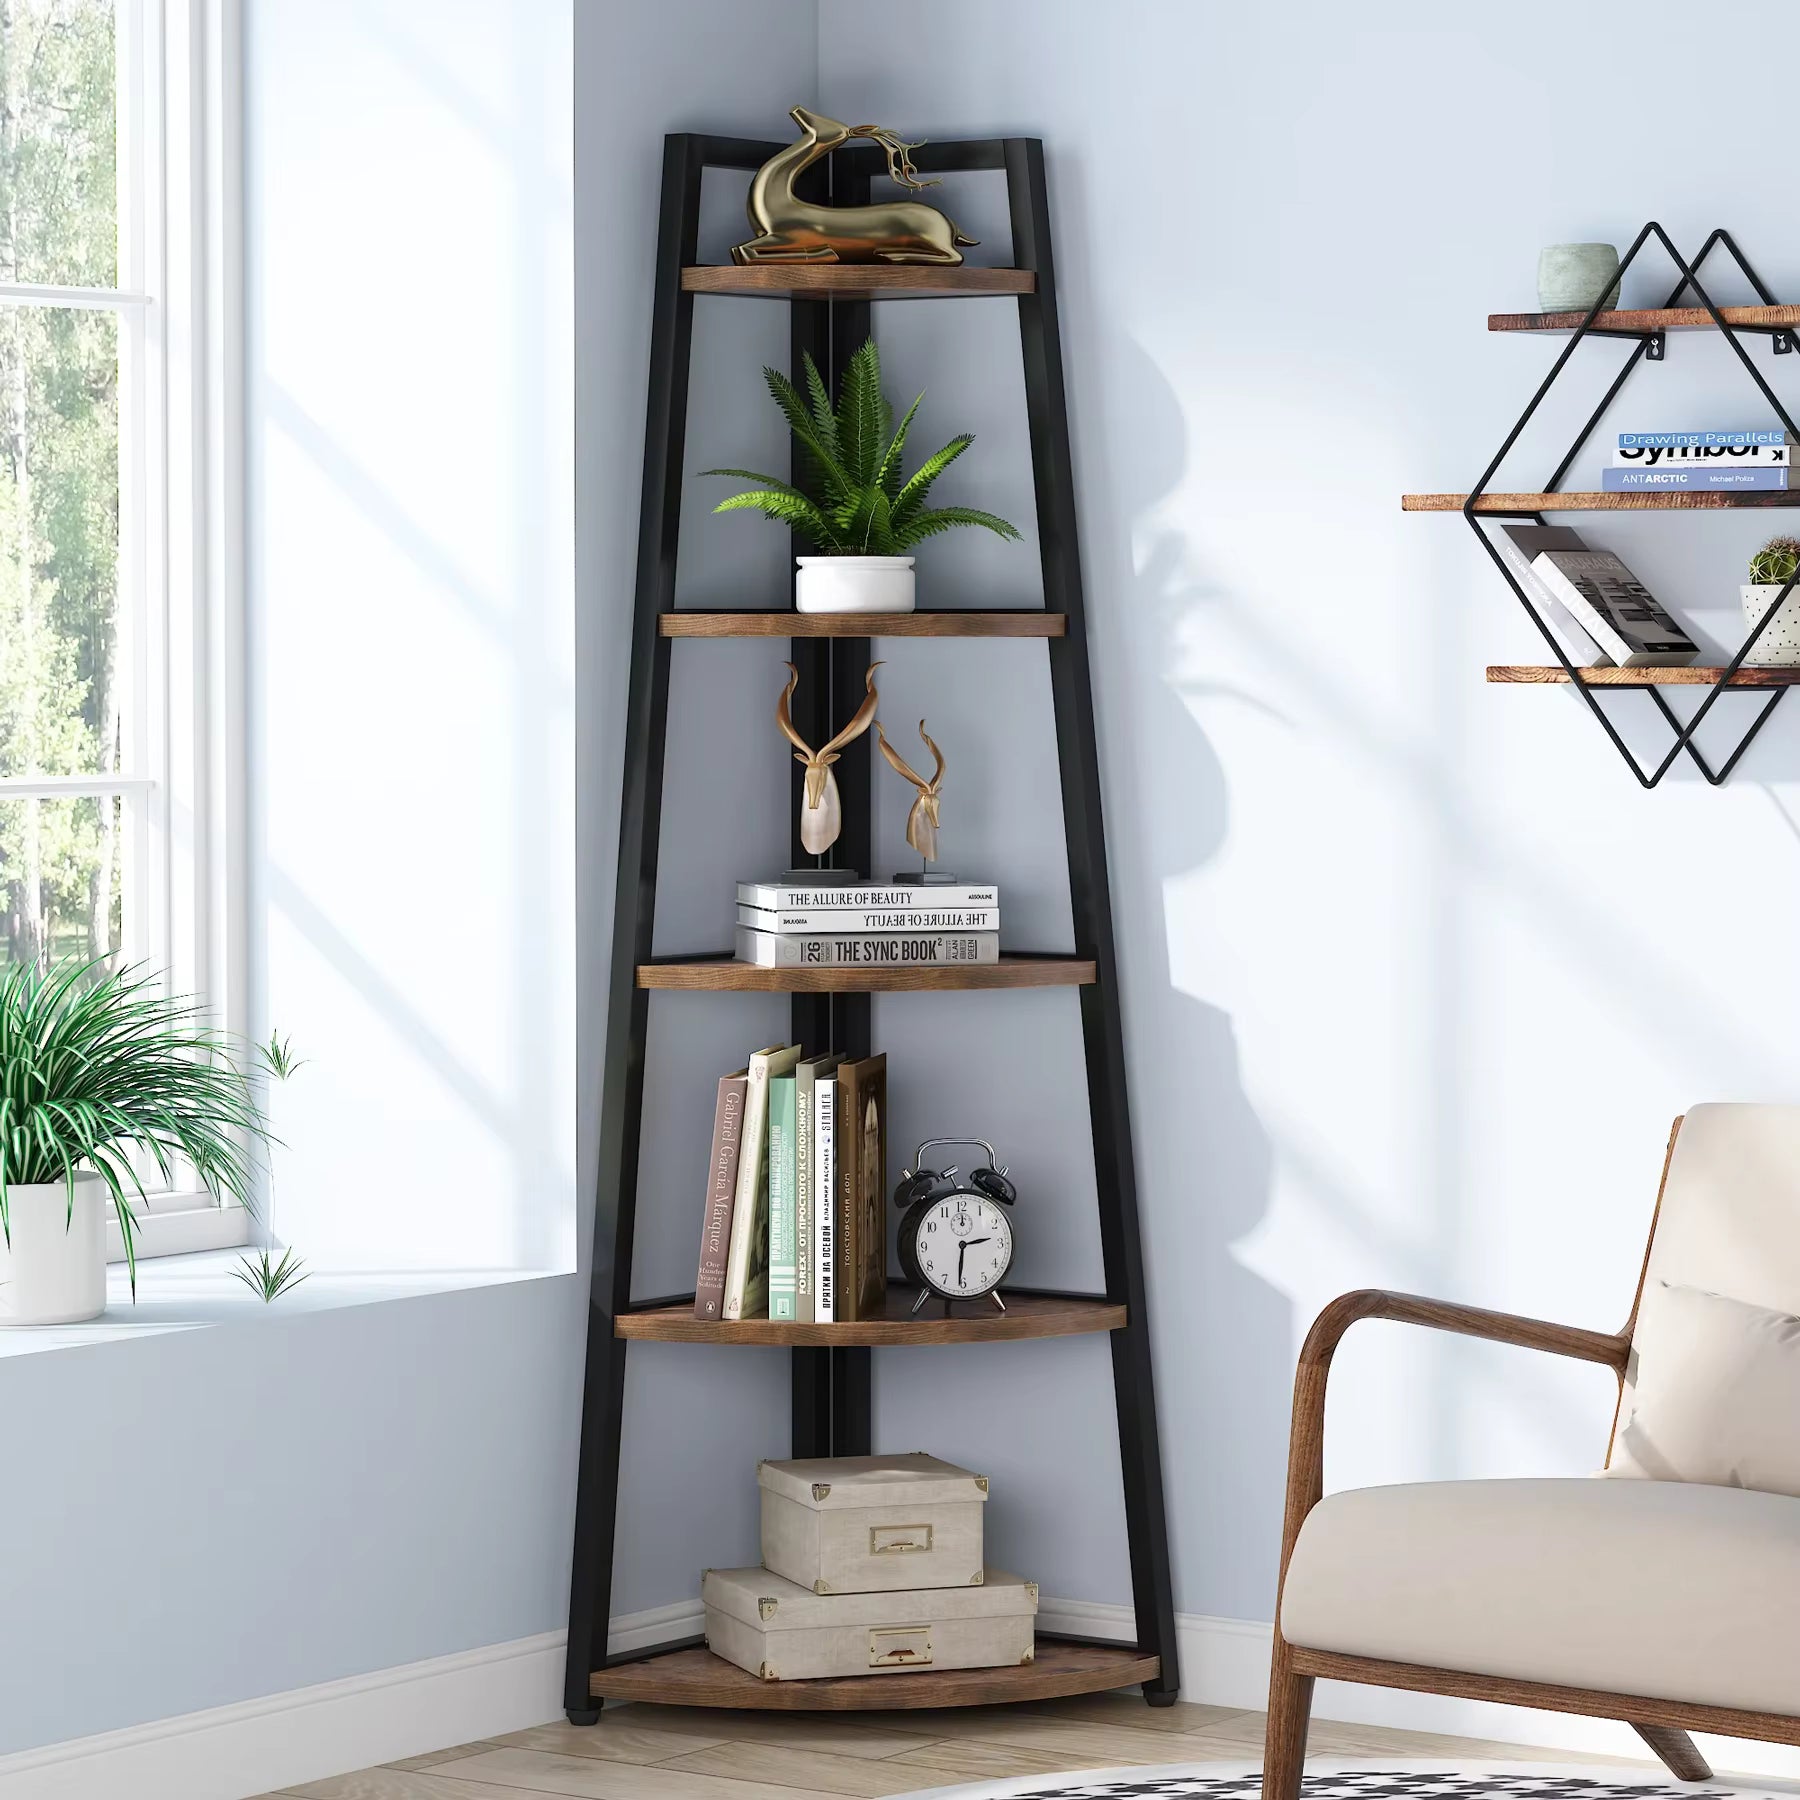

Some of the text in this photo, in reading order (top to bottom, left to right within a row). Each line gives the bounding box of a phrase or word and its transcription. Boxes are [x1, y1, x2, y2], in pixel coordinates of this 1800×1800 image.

[1622, 432, 1784, 447] Drawing Parallels
[1622, 473, 1755, 484] ANTARCTIC Michael Poliza
[788, 892, 913, 905] THE ALLURE OF BEAUTY
[808, 941, 821, 962] 26
[835, 941, 860, 962] THE
[864, 941, 899, 962] SYNC
[798, 1091, 806, 1160] СЛОЖНОМУ
[707, 1091, 740, 1253] Gabriel García Márquez
[798, 1162, 806, 1170] К
[772, 1125, 782, 1261] ПРАКТИКУМ ПО ПЛАНИРОВАНИЮ
[798, 1172, 806, 1230] ПРОСТОГО
[956, 1201, 967, 1212] 12
[940, 1206, 949, 1218] 11
[978, 1205, 982, 1216] 1
[927, 1222, 937, 1233] 10
[991, 1218, 998, 1230] 2
[798, 1231, 806, 1248] ОТ
[996, 1238, 1004, 1248] 3
[920, 1242, 928, 1253] 9
[820, 1225, 831, 1309] ПРЯТКИ НА ОСЕВОЙ
[926, 1260, 934, 1272] 8
[991, 1258, 998, 1268] 4
[941, 1274, 948, 1285] 7
[960, 1278, 967, 1288] 6
[980, 1272, 988, 1282] 5
